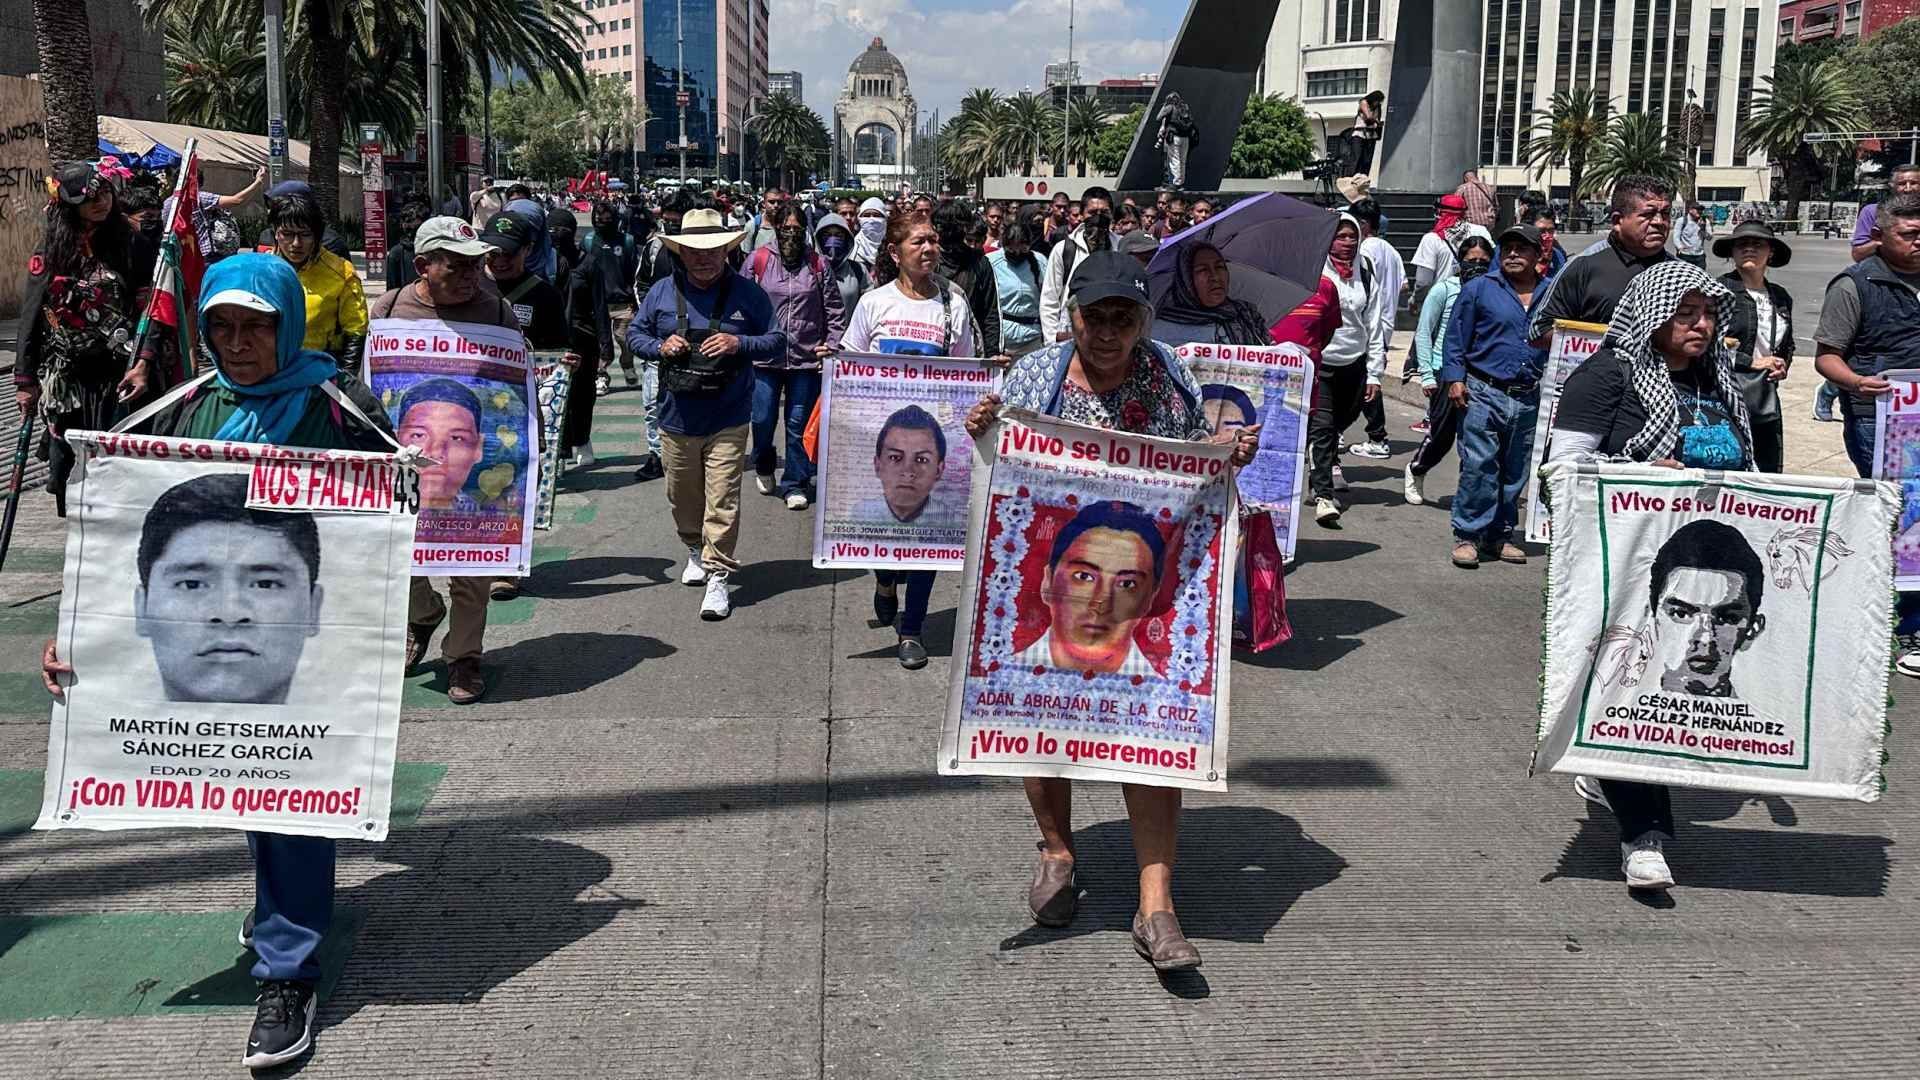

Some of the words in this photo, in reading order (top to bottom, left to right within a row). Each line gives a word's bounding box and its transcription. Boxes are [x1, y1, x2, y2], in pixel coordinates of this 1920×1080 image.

[371, 335, 399, 355] ¡Vivo
[405, 338, 426, 351] se
[433, 336, 449, 353] lo
[456, 335, 526, 364] llevaron!
[1194, 346, 1212, 358] se
[1218, 345, 1231, 360] lo
[1236, 346, 1304, 368] llevaron!
[1564, 337, 1600, 354] ¡Viv
[836, 361, 875, 379] ¡Vivo
[881, 365, 898, 378] se
[904, 364, 918, 378] lo
[924, 364, 990, 382] llevaron!
[1001, 426, 1064, 456] ¡Vivo
[1071, 440, 1100, 460] se
[1109, 440, 1130, 466] lo
[1139, 443, 1229, 478] llevaro
[250, 457, 301, 505] NOS
[307, 461, 393, 508] FALTAN
[394, 466, 420, 514] 43
[1612, 492, 1664, 513] ¡Vivo
[1672, 496, 1692, 512] se
[1720, 494, 1816, 524] llevaron!
[478, 522, 519, 531] ARZOLA
[413, 548, 509, 565] queremos!
[832, 544, 869, 559] ¡Vivo
[875, 544, 888, 557] lo
[1023, 694, 1090, 711] ABRAJÁN
[1100, 700, 1118, 713] DE
[1129, 702, 1148, 716] LA
[1158, 705, 1198, 722] CRUZ
[1638, 694, 1690, 712] CÉSAR
[1692, 702, 1754, 717] MANUEL
[109, 717, 188, 736] MARTÍN
[196, 722, 330, 739] GETSEMANY
[1606, 706, 1687, 726] GONZÁLEZ
[1692, 715, 1784, 736] HERNÁNDEZ
[122, 740, 224, 758] SÁNCHEZ
[232, 742, 313, 760] GARCÍA
[970, 730, 1028, 758] ¡Vivo
[1036, 732, 1058, 754] lo
[1065, 738, 1196, 770] queremos!
[1590, 722, 1629, 740] ¡Con
[1634, 724, 1675, 745] VIDA
[1679, 730, 1698, 746] lo
[1701, 734, 1794, 755] queremos!
[150, 766, 202, 776] EDAD
[208, 768, 231, 778] 20
[238, 767, 290, 780] AÑOS
[70, 777, 126, 809] ¡Con
[136, 779, 194, 809] VIDA
[202, 782, 223, 810] lo
[232, 787, 361, 816] queremos!
